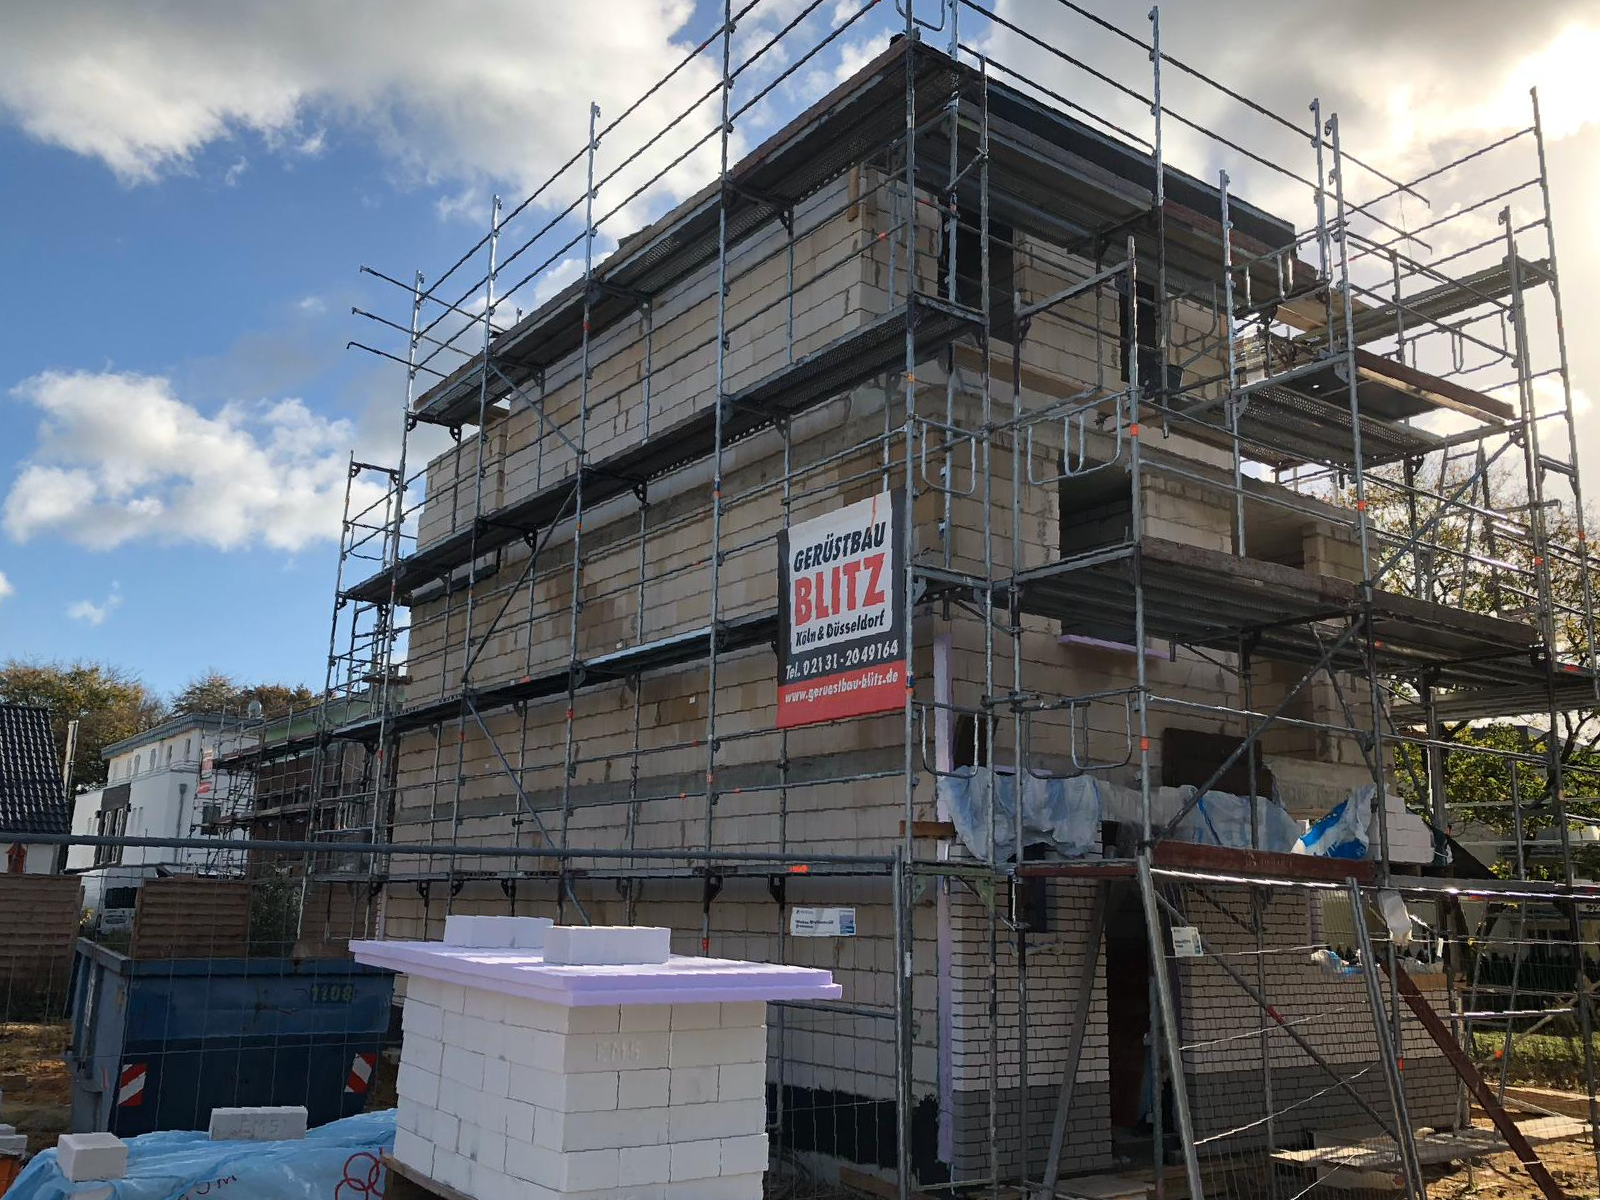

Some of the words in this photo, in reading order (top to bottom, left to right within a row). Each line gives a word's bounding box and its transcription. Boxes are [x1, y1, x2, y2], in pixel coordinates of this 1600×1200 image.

[793, 521, 886, 572] GERÜSTBAU
[794, 552, 885, 626] BLITZ
[796, 627, 817, 647] Köln
[817, 616, 825, 642] &
[827, 609, 885, 639] Düsseldorf
[785, 668, 899, 703] www.geruestbau-blitz.de
[786, 661, 801, 680] Tel.
